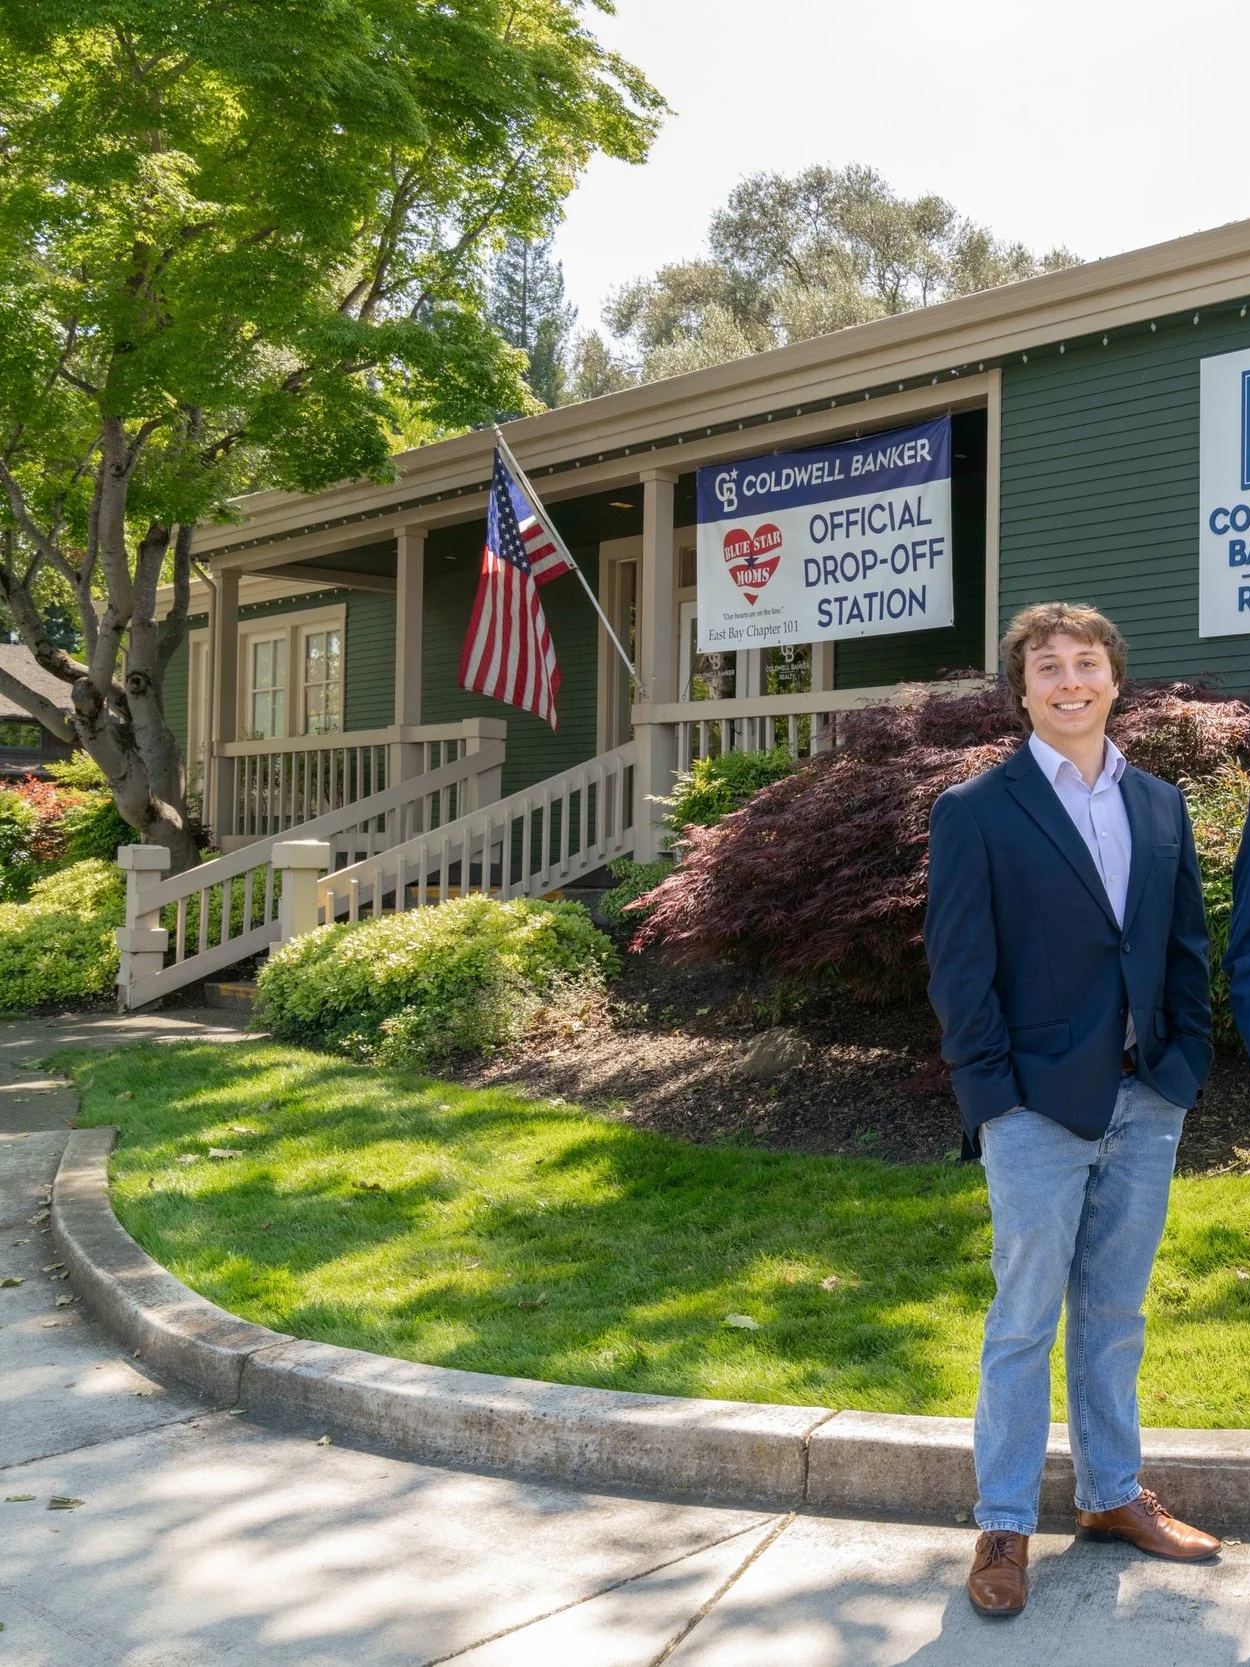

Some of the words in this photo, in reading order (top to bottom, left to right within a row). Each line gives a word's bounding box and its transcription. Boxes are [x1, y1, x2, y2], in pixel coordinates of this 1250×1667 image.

[743, 459, 844, 497] COLDWELL
[850, 438, 932, 477] BANKER
[809, 496, 932, 544] OFFICIAL
[725, 540, 750, 560] BLUE
[753, 531, 780, 551] STAR
[804, 537, 945, 588] DROP-OFF
[736, 567, 770, 586] MOMS
[734, 611, 748, 619] hearts
[817, 585, 927, 628] STATION
[709, 629, 726, 641] East
[728, 627, 744, 641] Bay
[746, 624, 781, 639] Chapter
[783, 620, 799, 634] 101
